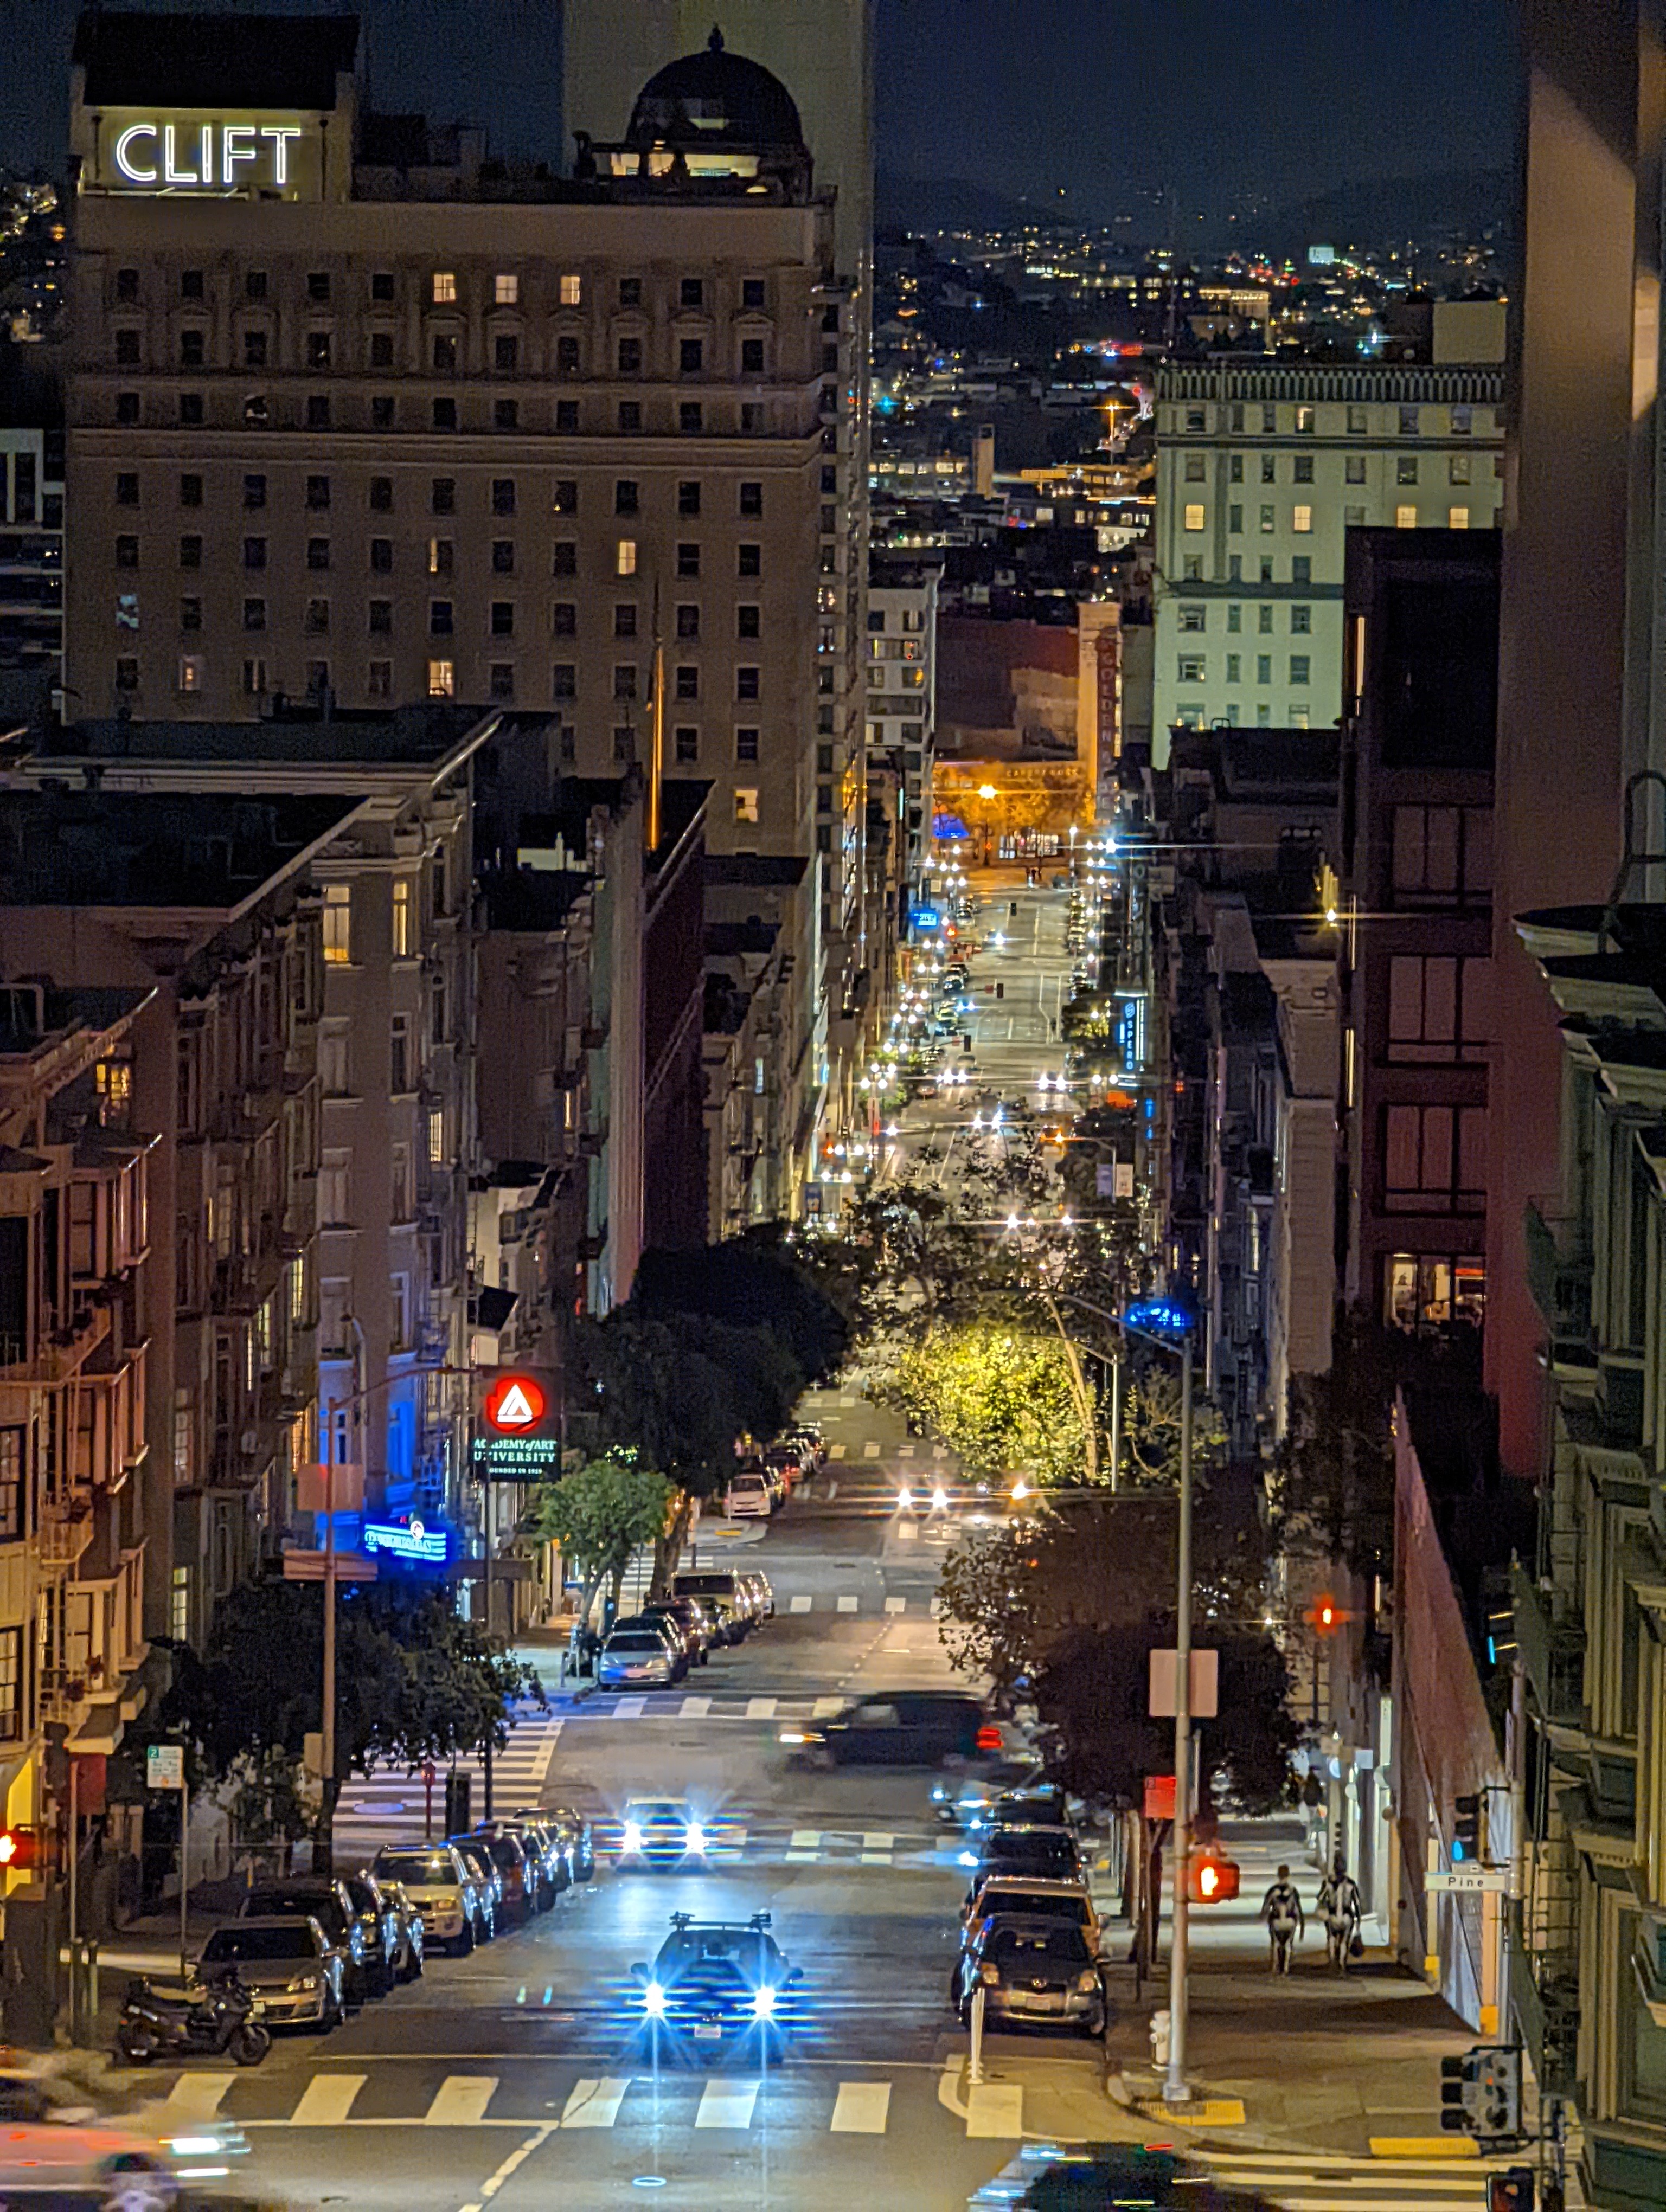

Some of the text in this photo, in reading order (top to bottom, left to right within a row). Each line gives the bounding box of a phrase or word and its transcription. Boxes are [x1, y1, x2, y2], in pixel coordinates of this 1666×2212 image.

[116, 124, 302, 184] CLIFT
[533, 1439, 556, 1450] ART
[1449, 1877, 1483, 1887] Pine
